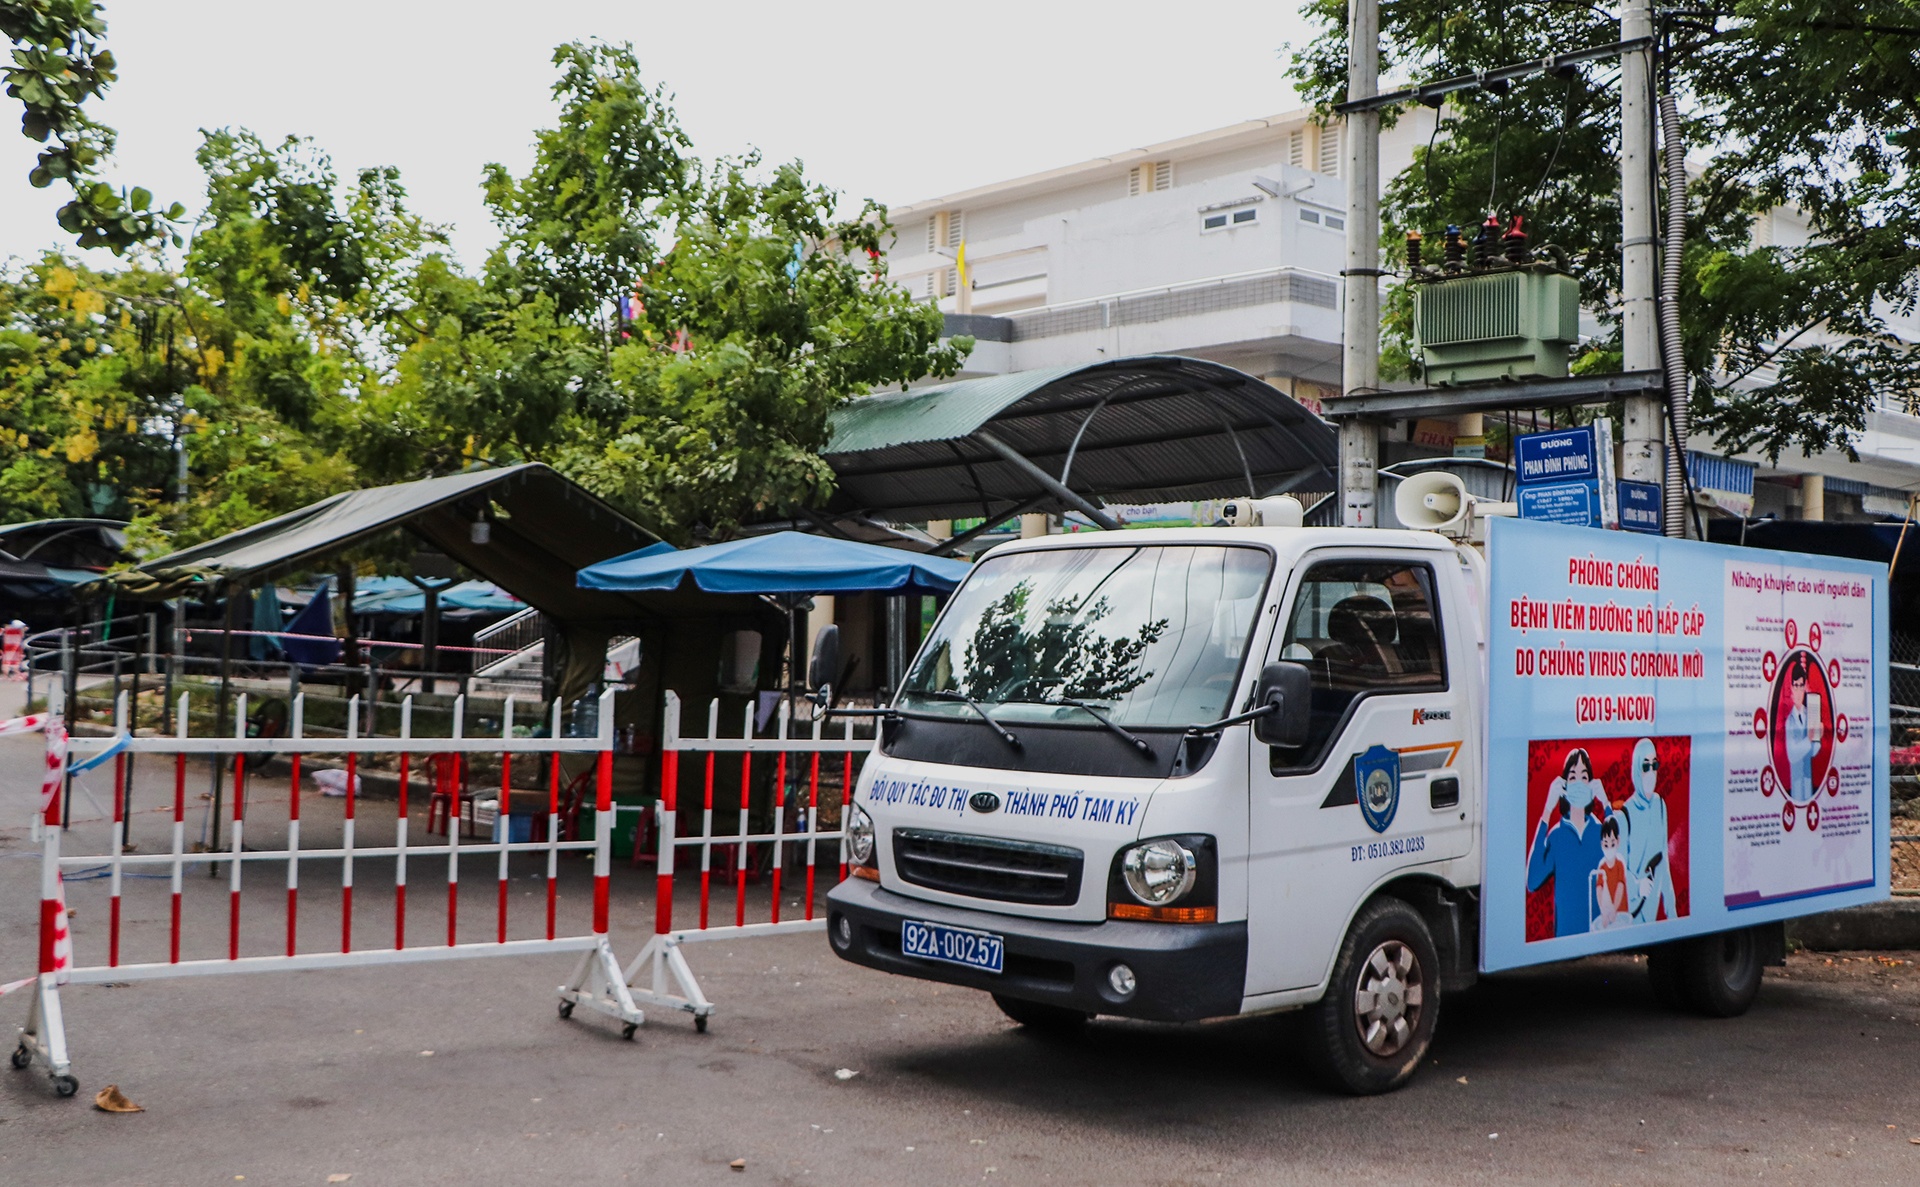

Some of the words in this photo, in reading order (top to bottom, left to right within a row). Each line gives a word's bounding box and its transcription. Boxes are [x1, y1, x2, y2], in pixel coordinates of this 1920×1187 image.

[1541, 438, 1573, 449] ĐƯỜNG
[1524, 460, 1543, 475] PHAN
[1544, 454, 1562, 473] ĐÌNH
[1563, 452, 1588, 471] PHÙNG
[1569, 553, 1613, 587] PHÒNG
[1617, 556, 1659, 590] CHỐNG
[1732, 571, 1762, 593] Những
[1764, 573, 1796, 595] khuyến
[1797, 577, 1811, 593] cáo
[1813, 578, 1825, 594] với
[1827, 580, 1850, 599] người
[1851, 581, 1866, 598] dân
[1511, 595, 1548, 634] BỆNH
[1552, 598, 1585, 630] VIÊM
[1589, 601, 1633, 632] ĐƯỜNG
[1637, 604, 1653, 633] HÔ
[1657, 602, 1679, 635] HẤP
[1682, 604, 1704, 636] CẤP
[1516, 649, 1534, 676] DO
[1539, 641, 1585, 676] CHỦNG
[1589, 651, 1626, 677] VIRUS
[1631, 652, 1679, 677] CORONA
[1682, 649, 1704, 677] MỚI
[1576, 696, 1655, 724] (2019-NCOV)
[887, 781, 909, 806] QUY
[948, 788, 970, 817] THỊ
[972, 794, 997, 808] KIA
[1004, 787, 1049, 817] THÀNH
[1049, 790, 1084, 819] PHỐ
[1082, 797, 1114, 823] TAM
[1115, 797, 1139, 825] KỲ
[1351, 846, 1366, 862] ĐT:
[906, 925, 1001, 967] 92A-002.57
